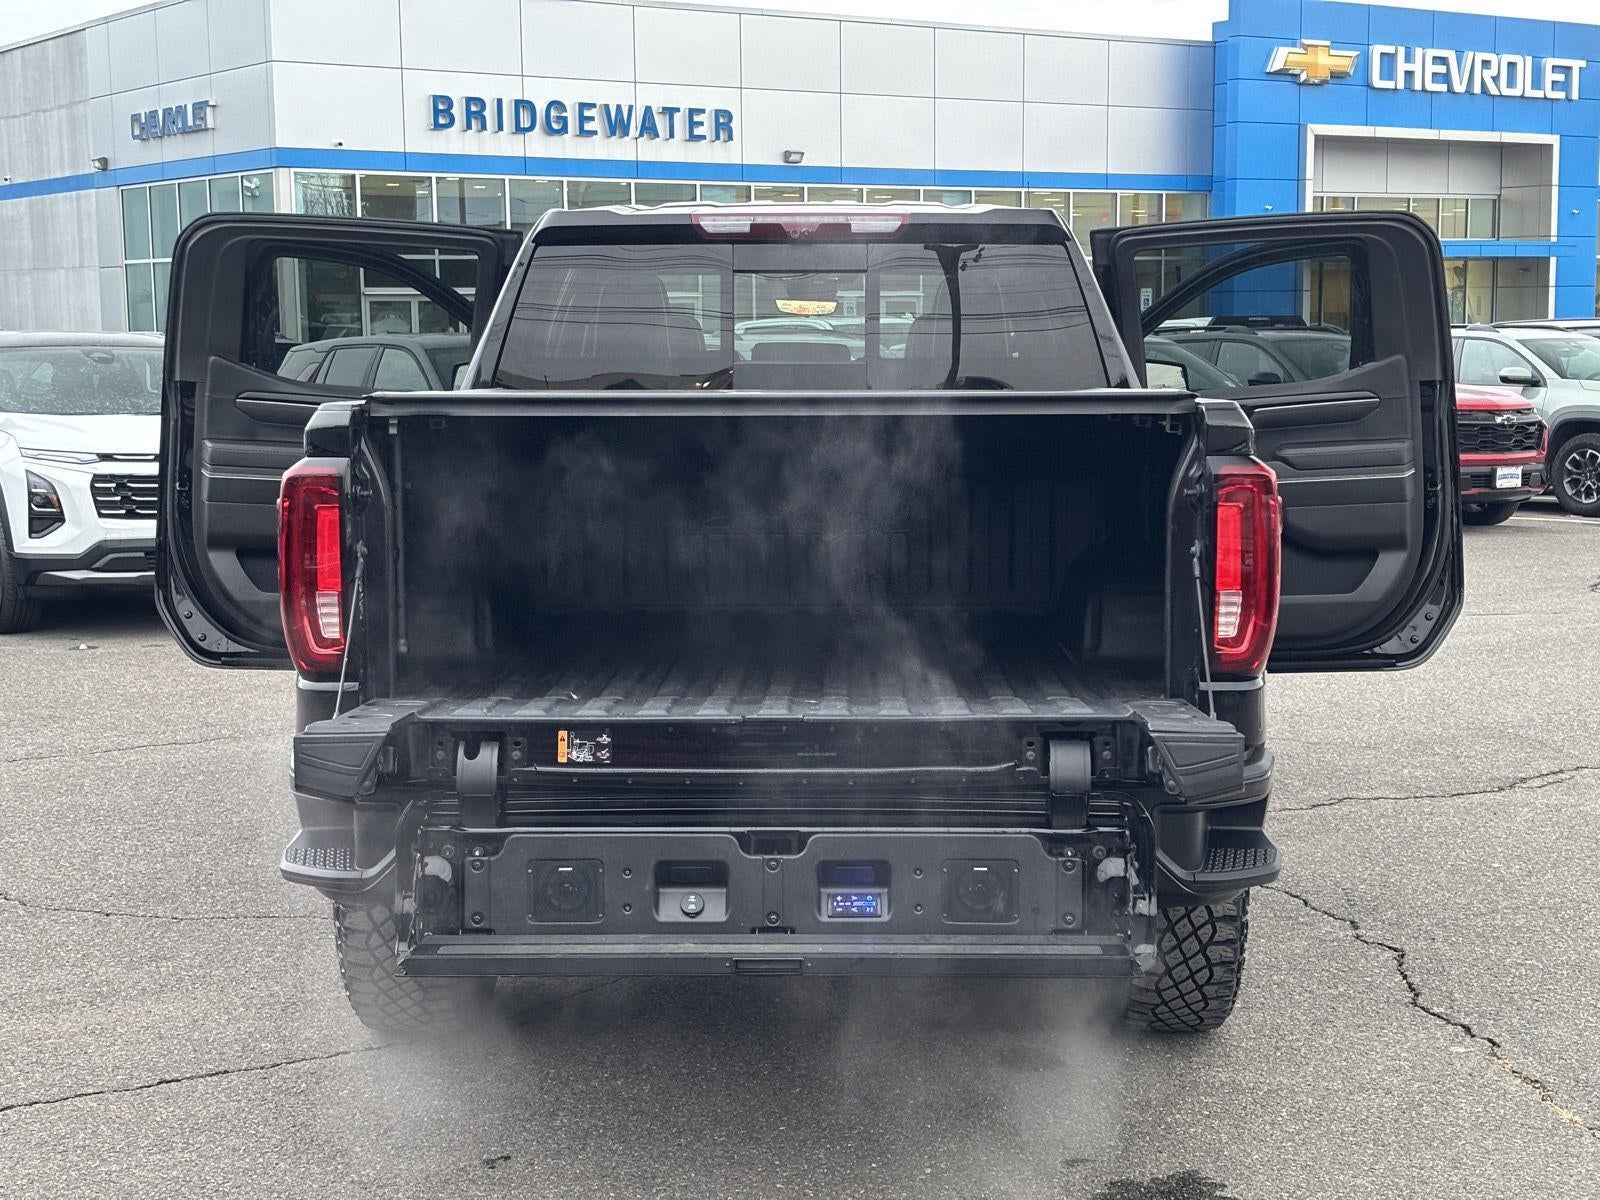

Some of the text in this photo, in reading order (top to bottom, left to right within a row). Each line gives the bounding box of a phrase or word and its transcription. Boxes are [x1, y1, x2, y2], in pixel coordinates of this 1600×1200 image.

[1370, 44, 1587, 100] CHEVROLET
[130, 99, 217, 141] CHEVROLET
[430, 94, 734, 142] BRIDGEWATER
